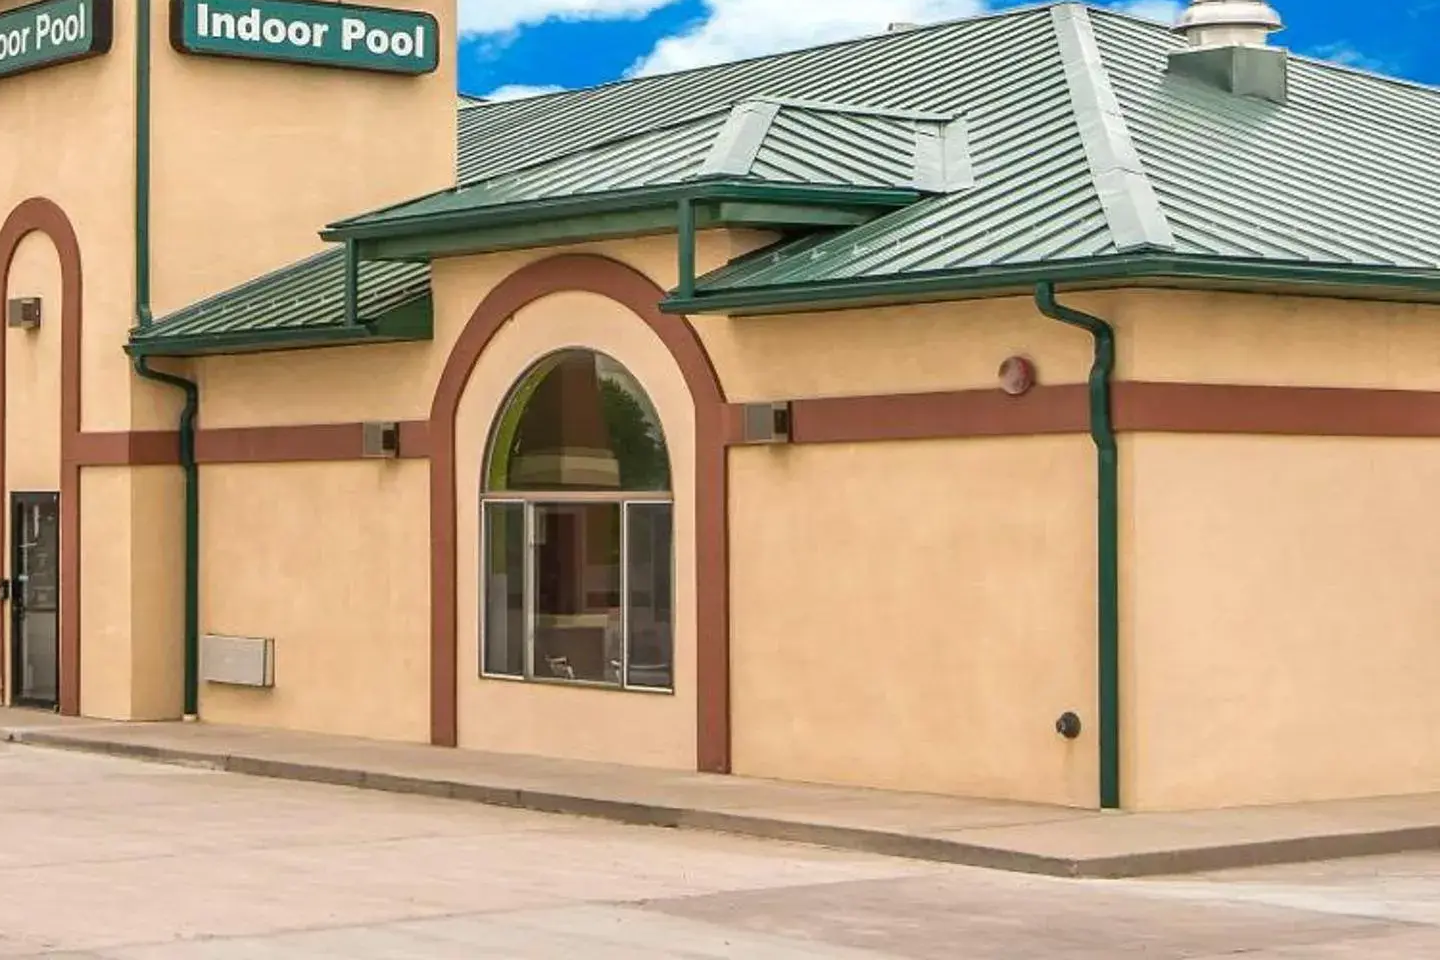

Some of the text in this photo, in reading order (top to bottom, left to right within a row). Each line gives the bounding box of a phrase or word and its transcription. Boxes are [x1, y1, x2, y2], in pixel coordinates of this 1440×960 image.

[35, 3, 86, 53] Pool
[197, 3, 425, 58] Indoor Pool
